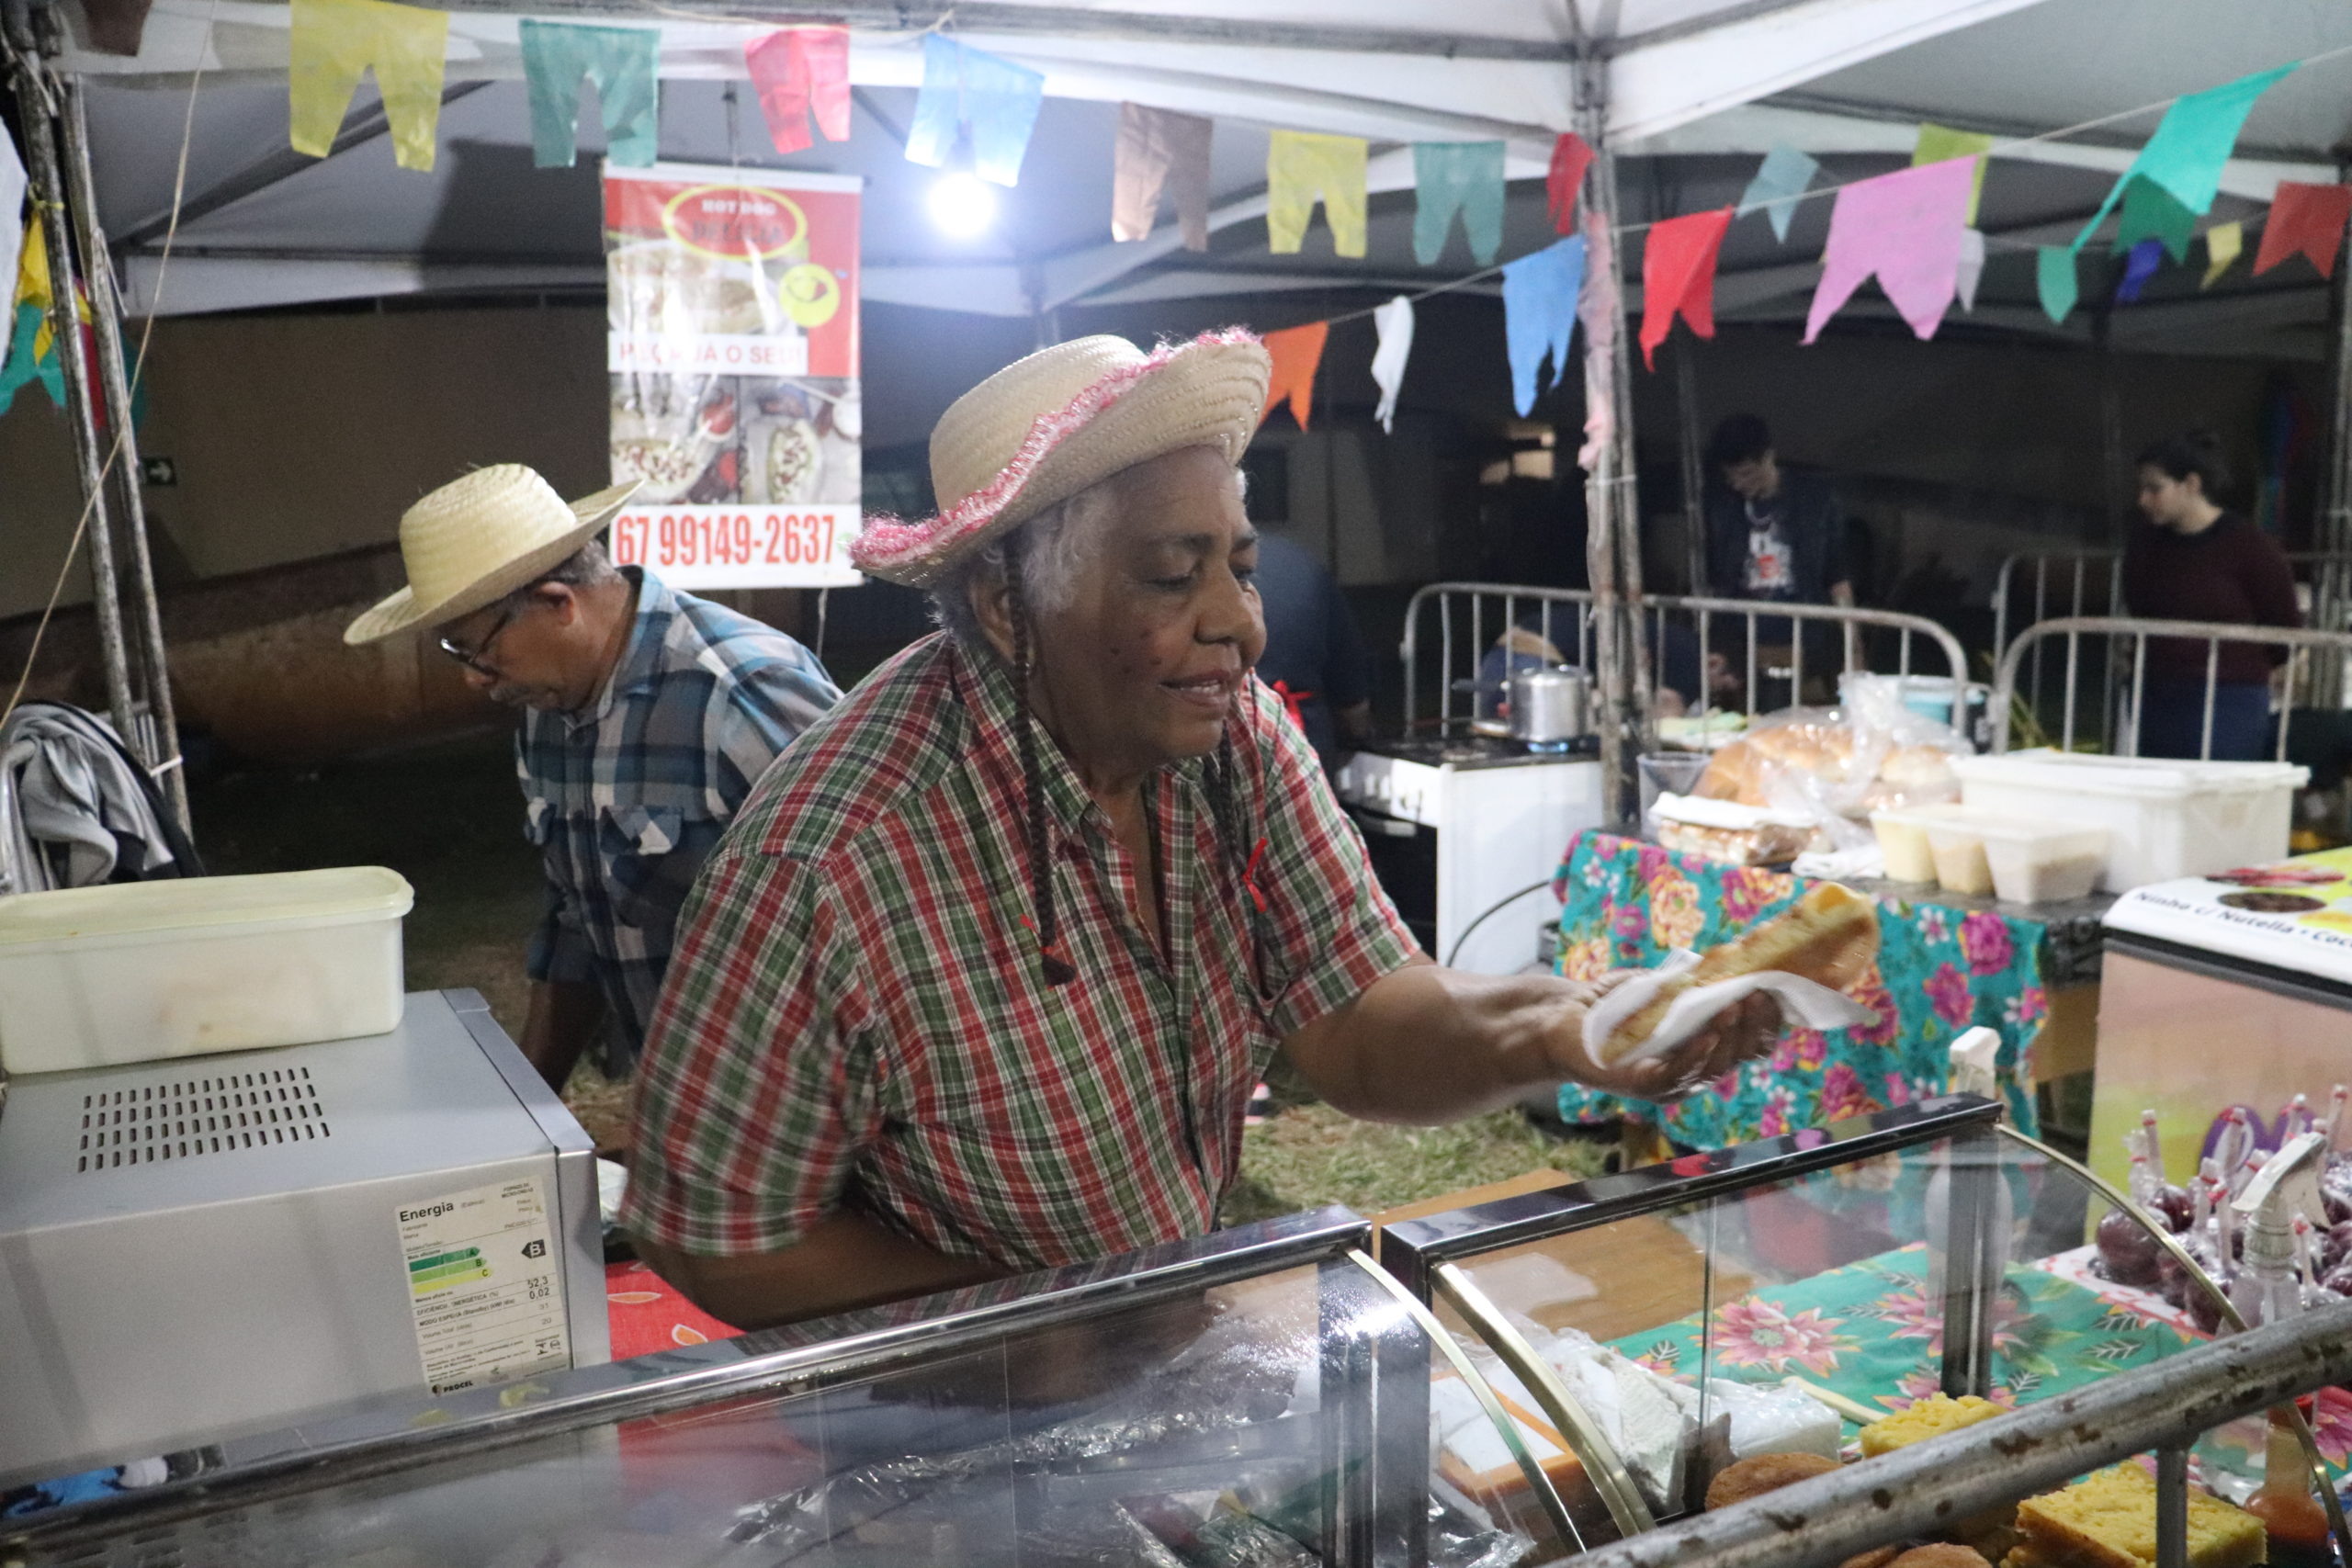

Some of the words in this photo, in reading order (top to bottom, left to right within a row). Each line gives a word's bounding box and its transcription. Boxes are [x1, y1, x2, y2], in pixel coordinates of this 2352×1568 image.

[726, 346, 742, 364] O
[616, 514, 650, 566] 67
[660, 514, 835, 566] 99149-2637
[2136, 892, 2190, 910] Ninho
[2219, 909, 2294, 934] Nutella
[400, 1201, 454, 1223] Energia
[530, 1244, 541, 1256] B
[476, 1258, 482, 1267] B
[529, 1287, 550, 1301] 0,02
[443, 1381, 473, 1393] PROCEL
